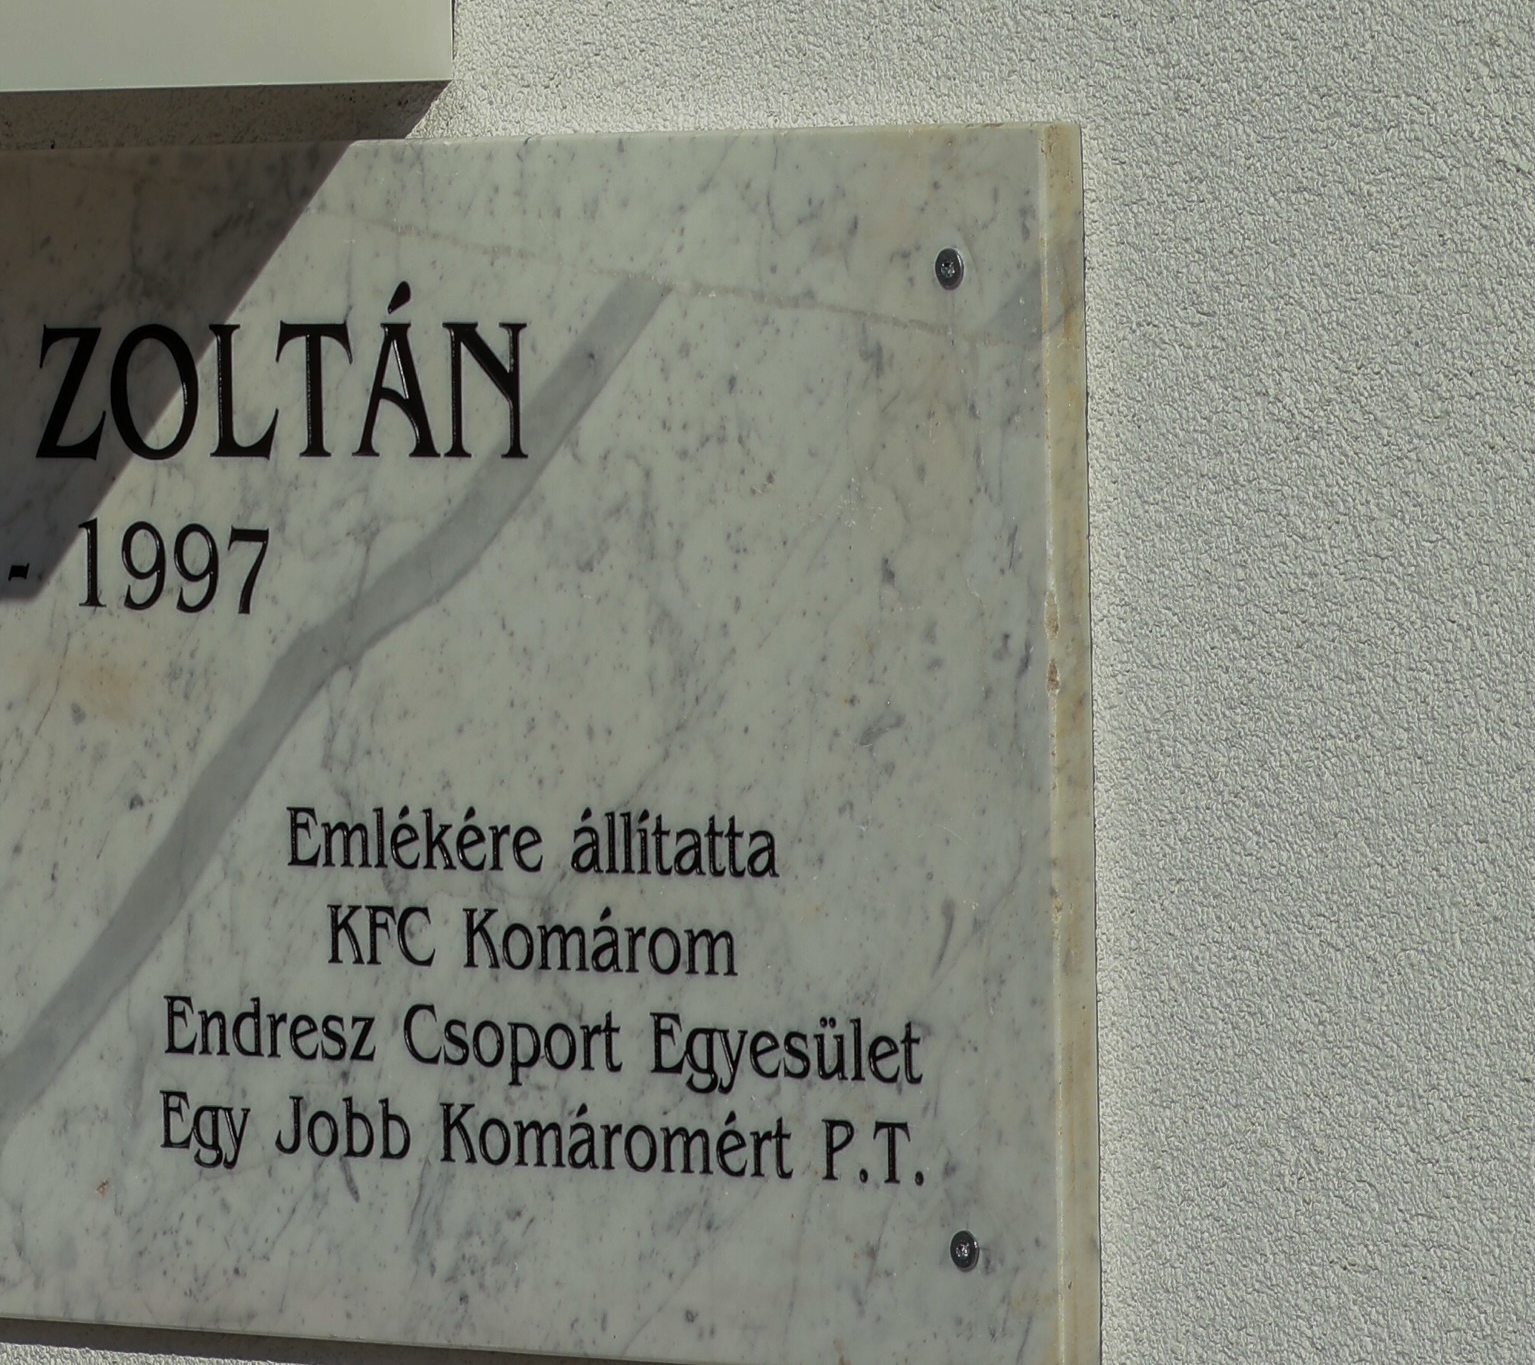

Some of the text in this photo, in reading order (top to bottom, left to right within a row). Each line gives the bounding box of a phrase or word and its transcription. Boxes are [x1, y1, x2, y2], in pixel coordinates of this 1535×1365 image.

[37, 281, 529, 462] ZOLTÁN
[77, 517, 270, 615] 1997
[286, 804, 779, 879] Emlékére állítatta
[327, 904, 738, 978] KFC Komárom
[163, 995, 923, 1095] Endresz Csoport Egyesület
[159, 1089, 925, 1188] Egy Jobb Komáromért P.T.
